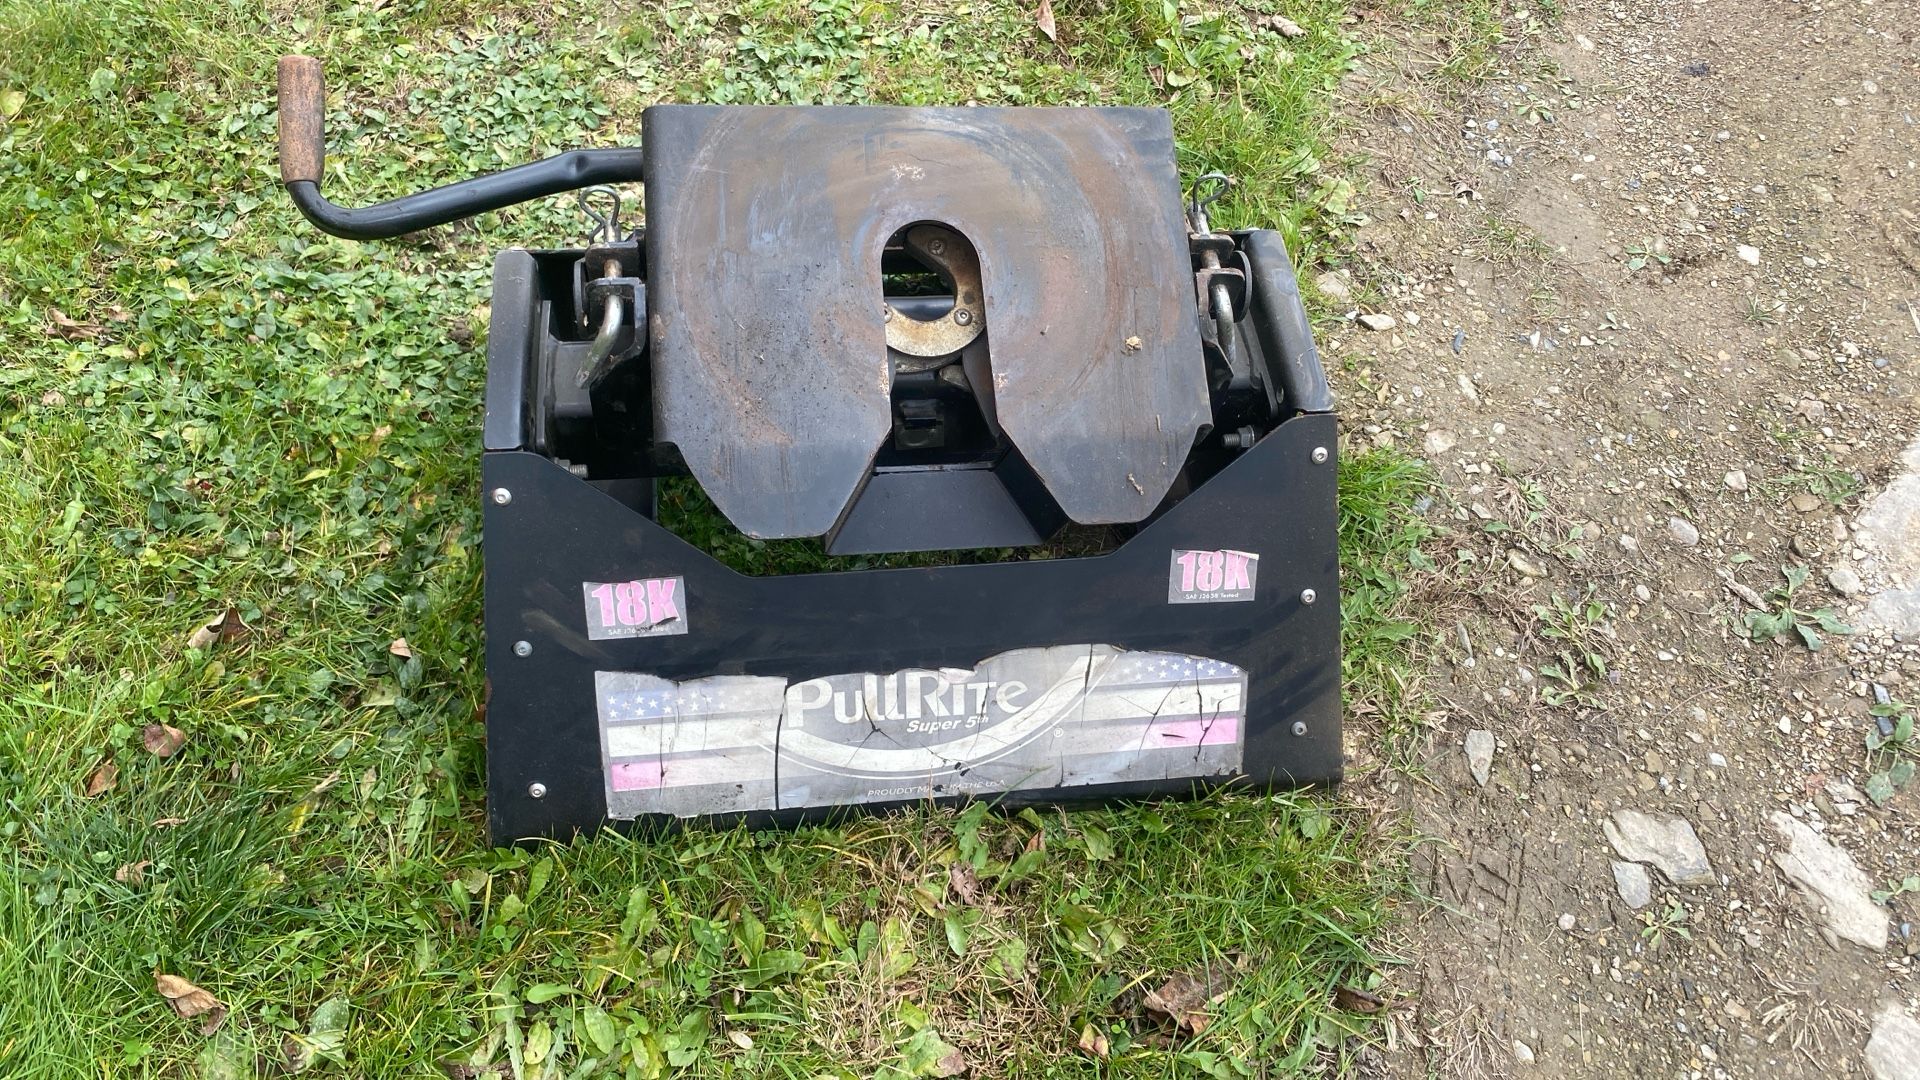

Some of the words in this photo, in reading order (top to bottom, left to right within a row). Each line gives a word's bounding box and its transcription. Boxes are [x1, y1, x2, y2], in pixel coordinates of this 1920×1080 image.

[1177, 551, 1251, 592] 18K
[591, 579, 682, 627] 18K
[906, 719, 962, 735] Super
[965, 715, 989, 729] 5th
[867, 786, 914, 797] PROUDLY
